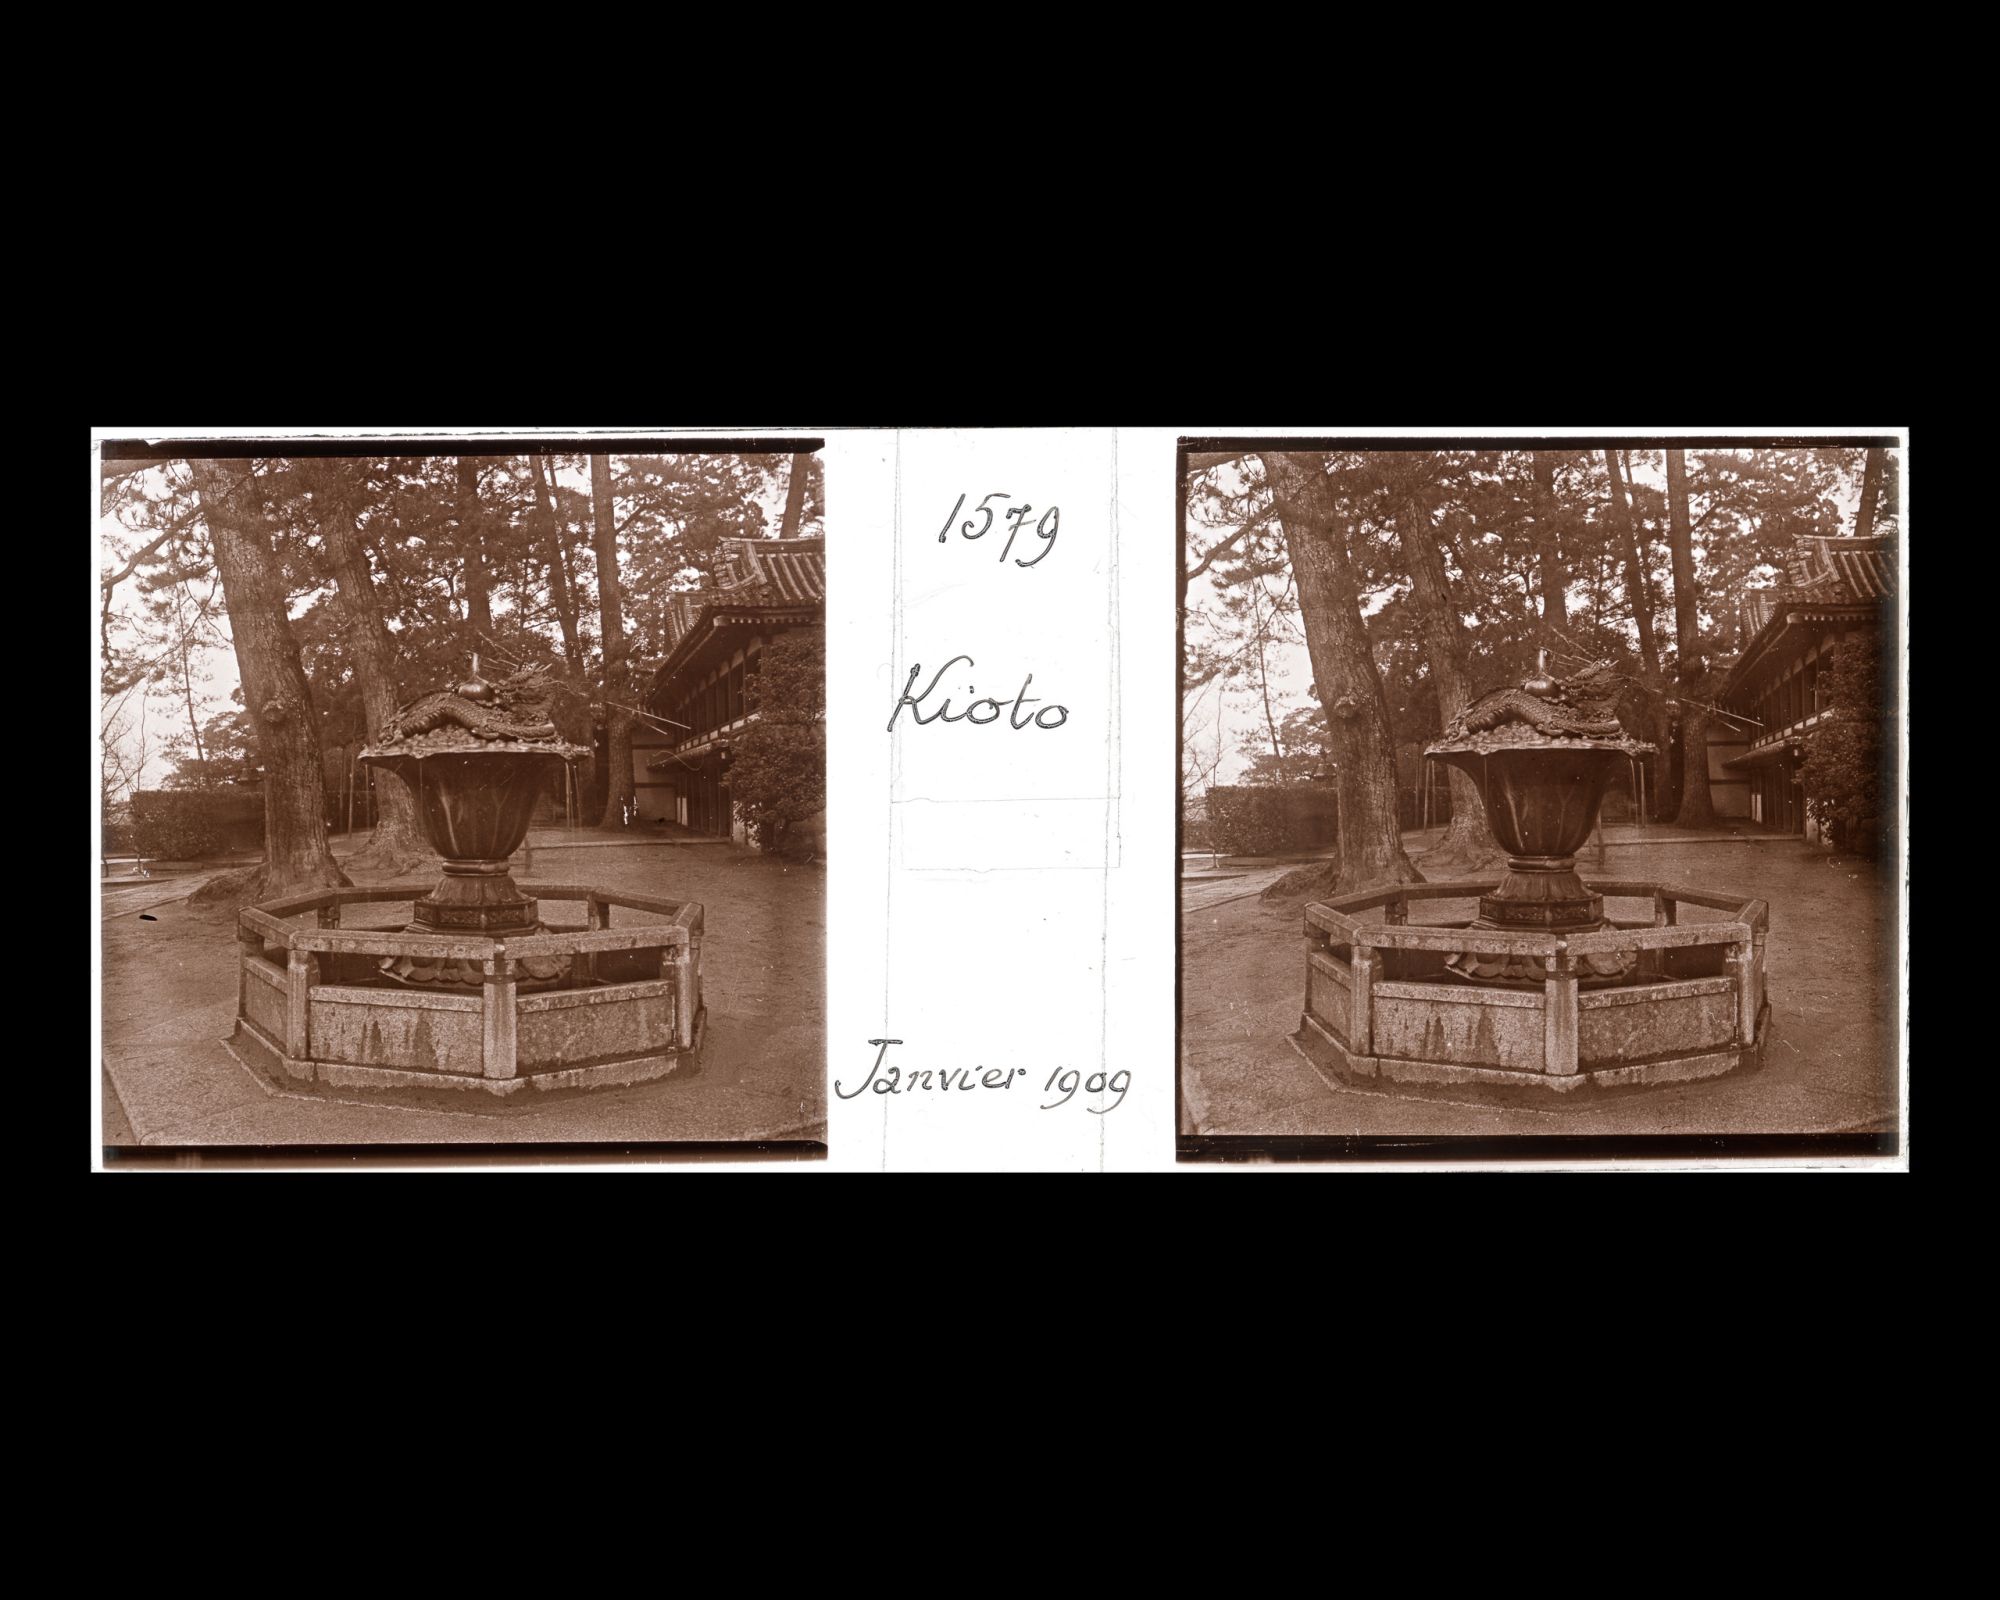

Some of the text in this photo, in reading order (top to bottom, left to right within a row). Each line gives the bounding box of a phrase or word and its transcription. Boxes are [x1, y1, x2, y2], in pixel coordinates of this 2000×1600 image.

[938, 492, 1060, 568] 1579
[887, 655, 1070, 733] Kioto
[834, 1038, 1132, 1114] Janvier 1909
